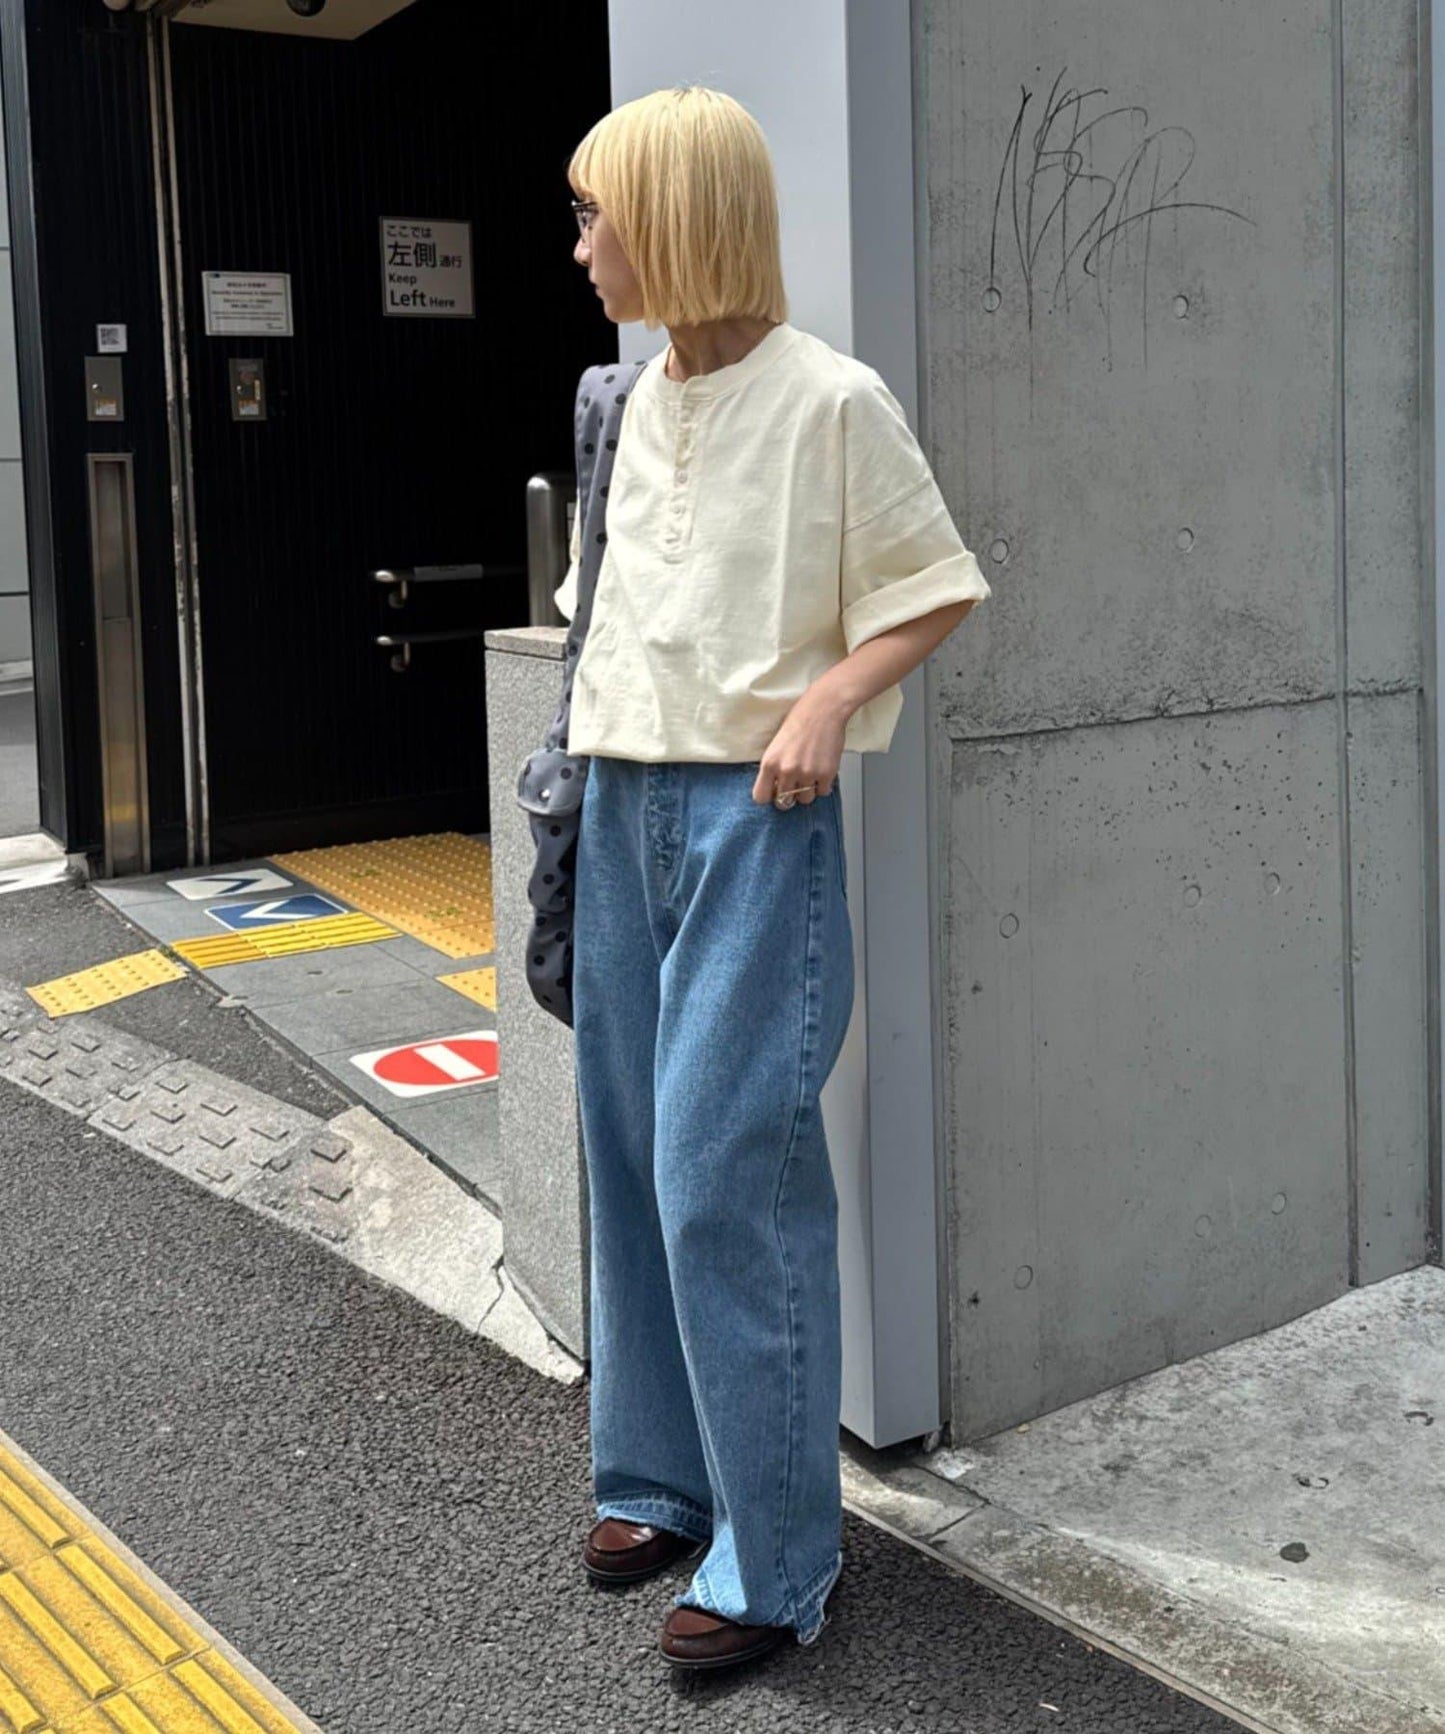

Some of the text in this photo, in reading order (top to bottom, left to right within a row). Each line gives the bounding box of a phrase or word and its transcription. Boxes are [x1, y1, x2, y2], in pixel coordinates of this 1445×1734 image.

[387, 225, 432, 238] ここでは
[388, 273, 417, 286] Keep
[390, 289, 455, 307] Left Here
